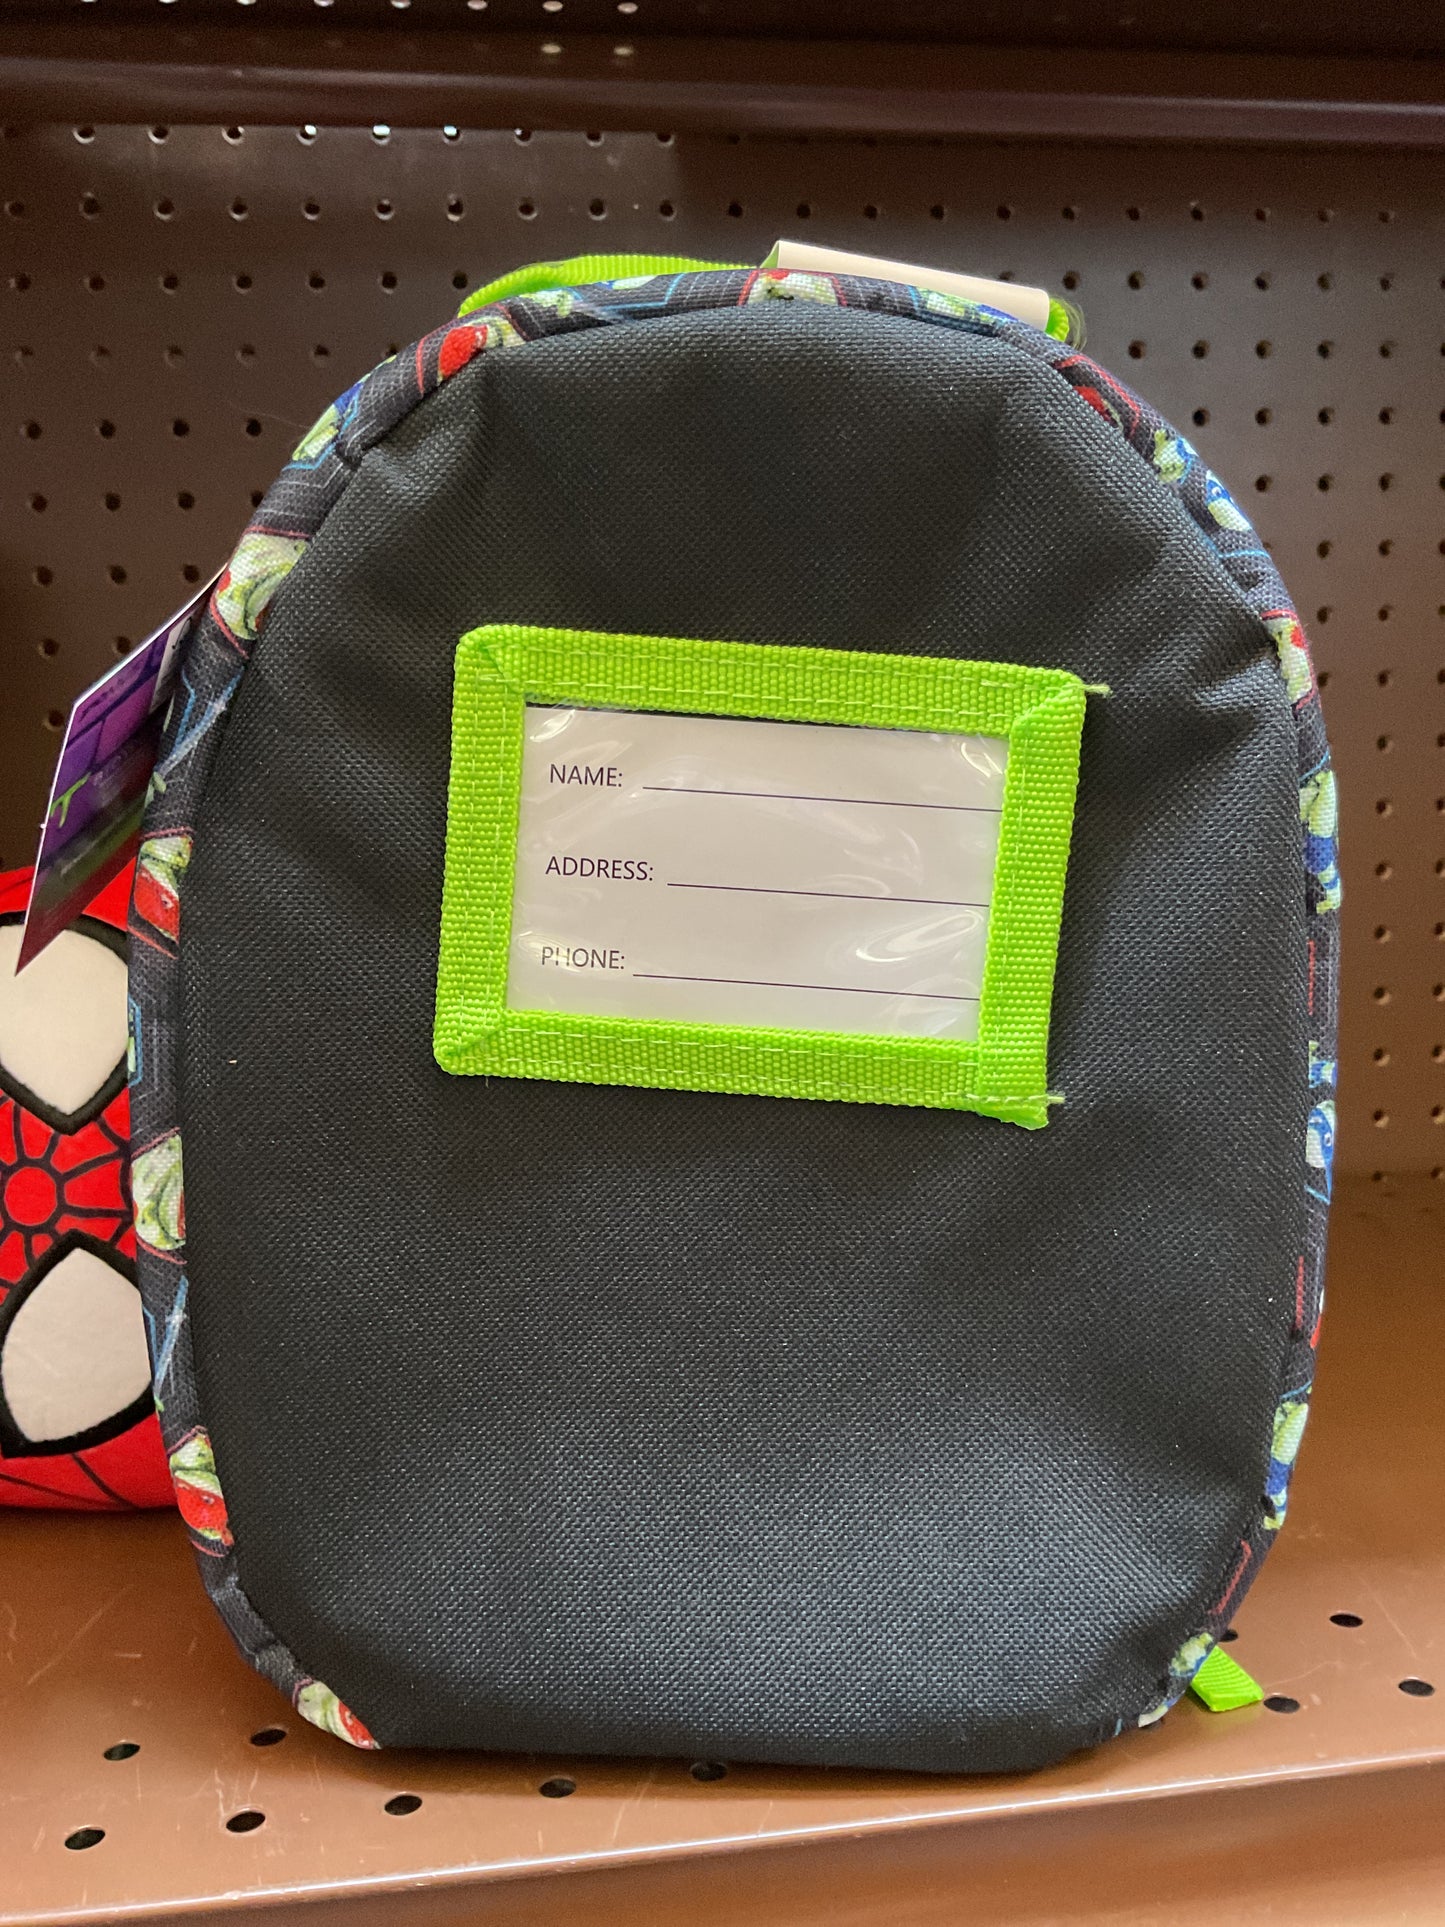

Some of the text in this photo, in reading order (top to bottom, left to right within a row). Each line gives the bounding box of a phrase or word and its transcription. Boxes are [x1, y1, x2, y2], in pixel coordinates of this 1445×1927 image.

[549, 763, 623, 788] NAME:
[545, 855, 654, 882] ADDRESS:
[541, 946, 625, 970] PHONE:
